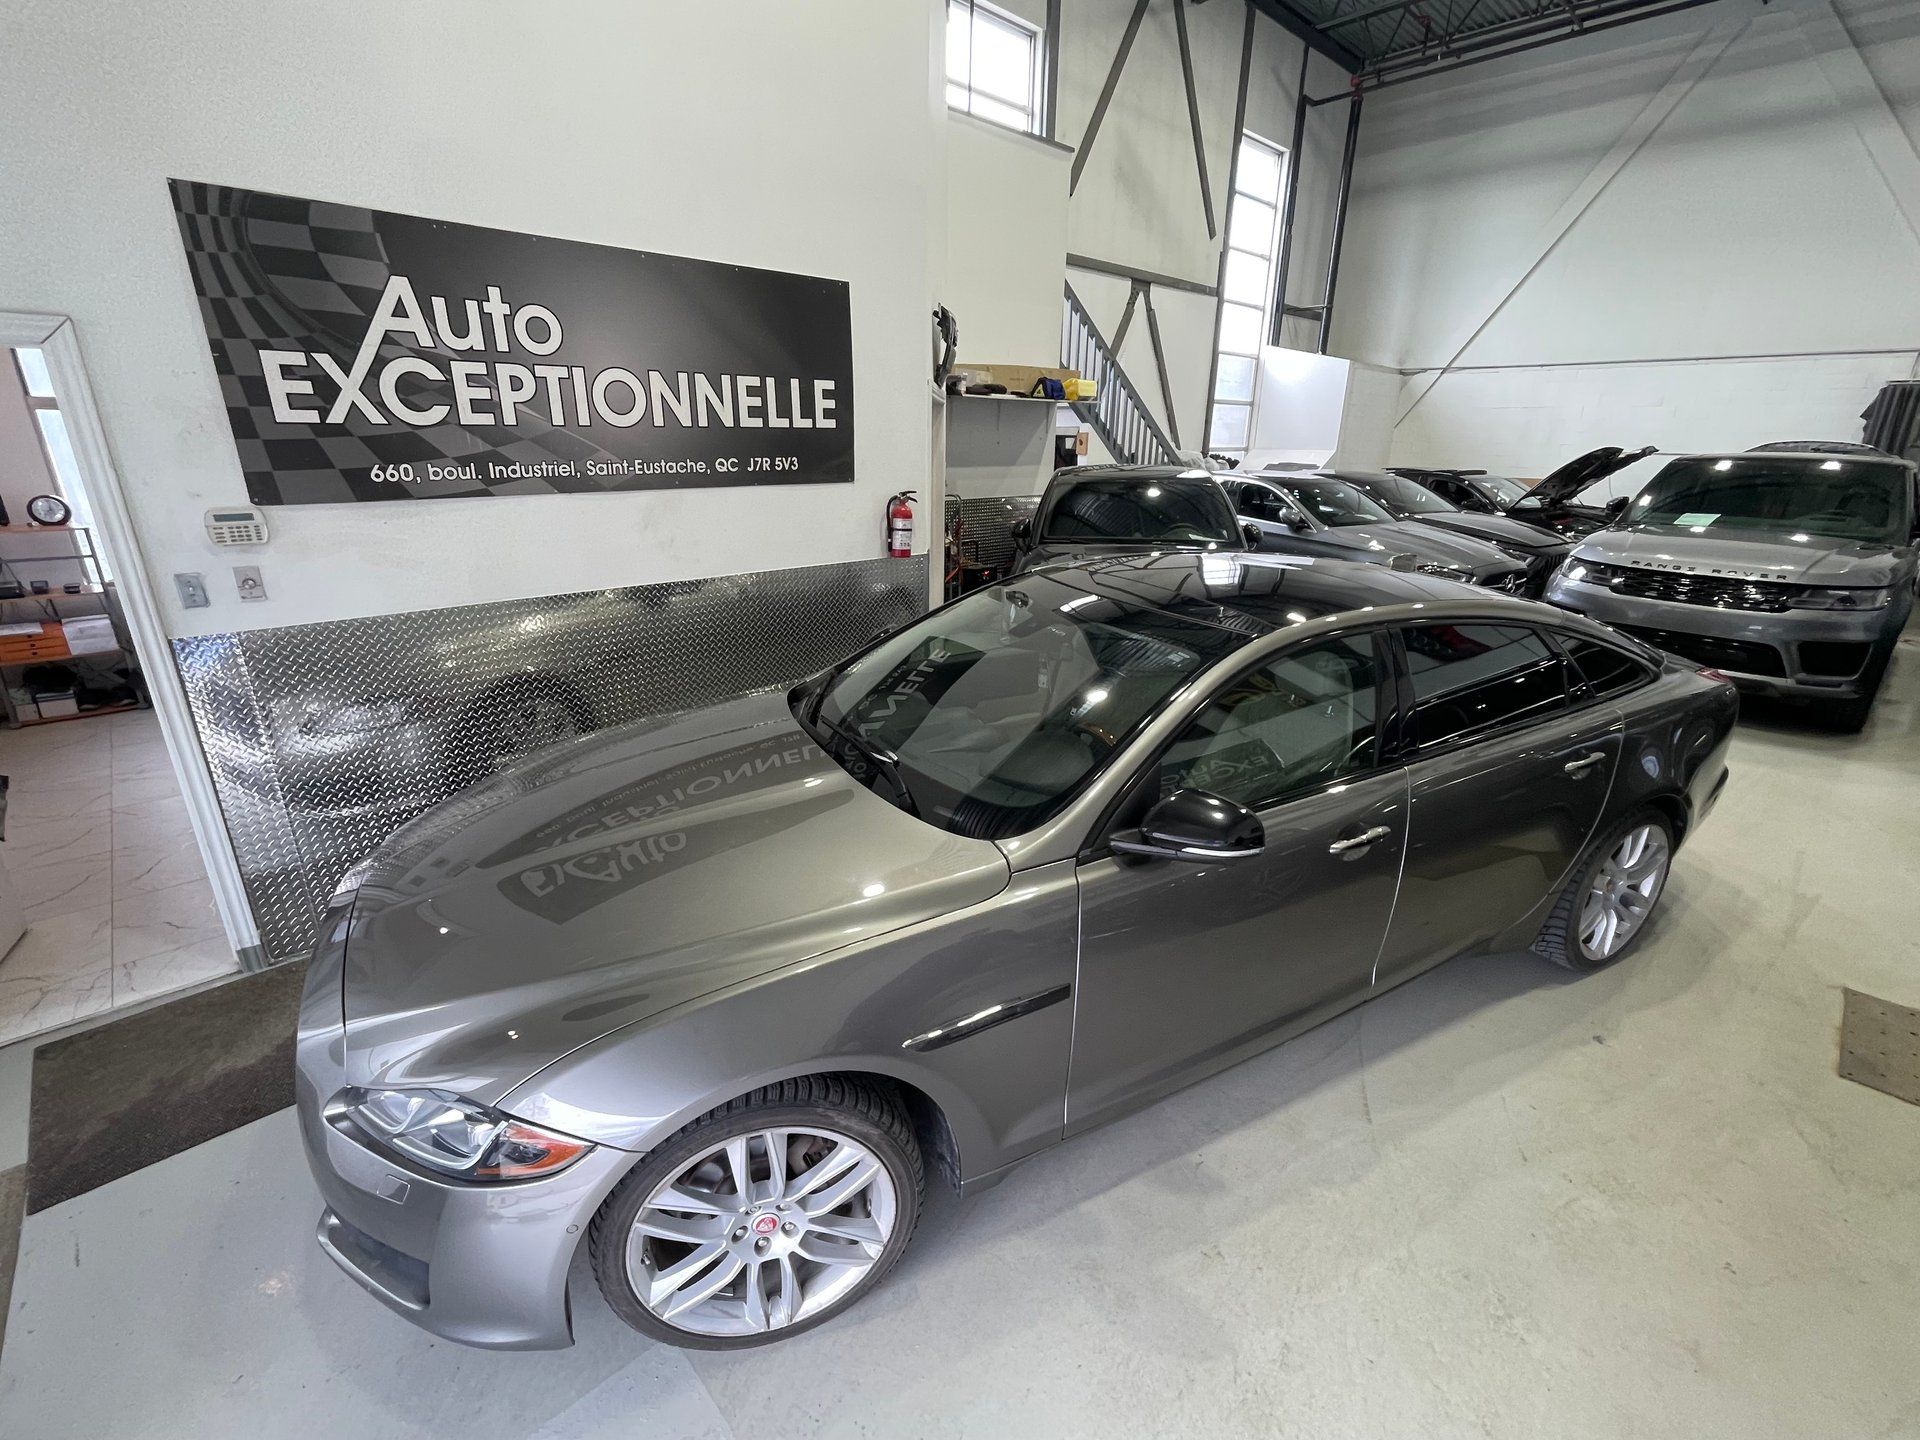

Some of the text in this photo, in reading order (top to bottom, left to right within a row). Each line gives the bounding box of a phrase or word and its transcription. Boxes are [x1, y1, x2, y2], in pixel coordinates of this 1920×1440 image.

[358, 274, 563, 357] Auto
[258, 349, 838, 429] EXCEPTIONNELLE
[370, 456, 799, 484] 660, boul. Industriel, Saint-Eustache, QC J7R 5V3
[1631, 560, 1788, 581] RANGE ROVER
